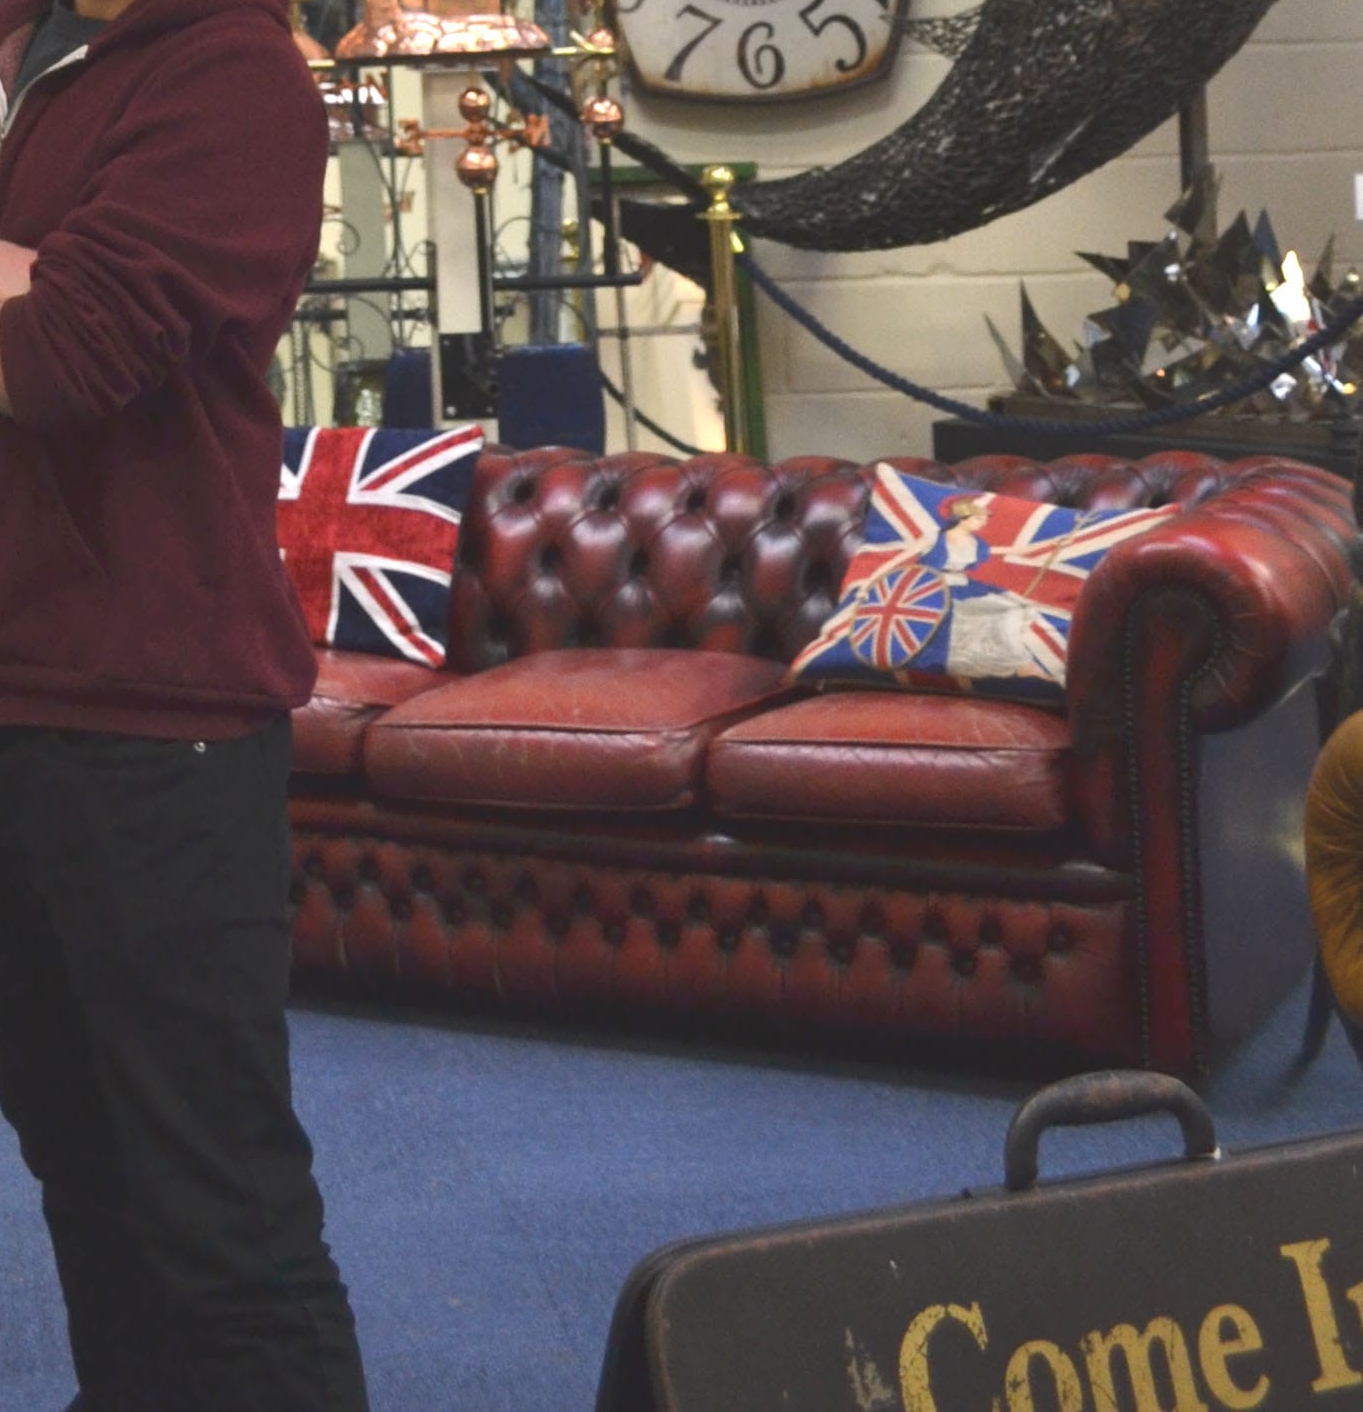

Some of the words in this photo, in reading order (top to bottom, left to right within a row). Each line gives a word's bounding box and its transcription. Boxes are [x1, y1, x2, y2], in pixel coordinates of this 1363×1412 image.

[663, 3, 724, 82] 7
[737, 21, 785, 90] 6
[899, 1301, 1270, 1412] Come
[1280, 1237, 1363, 1393] I
